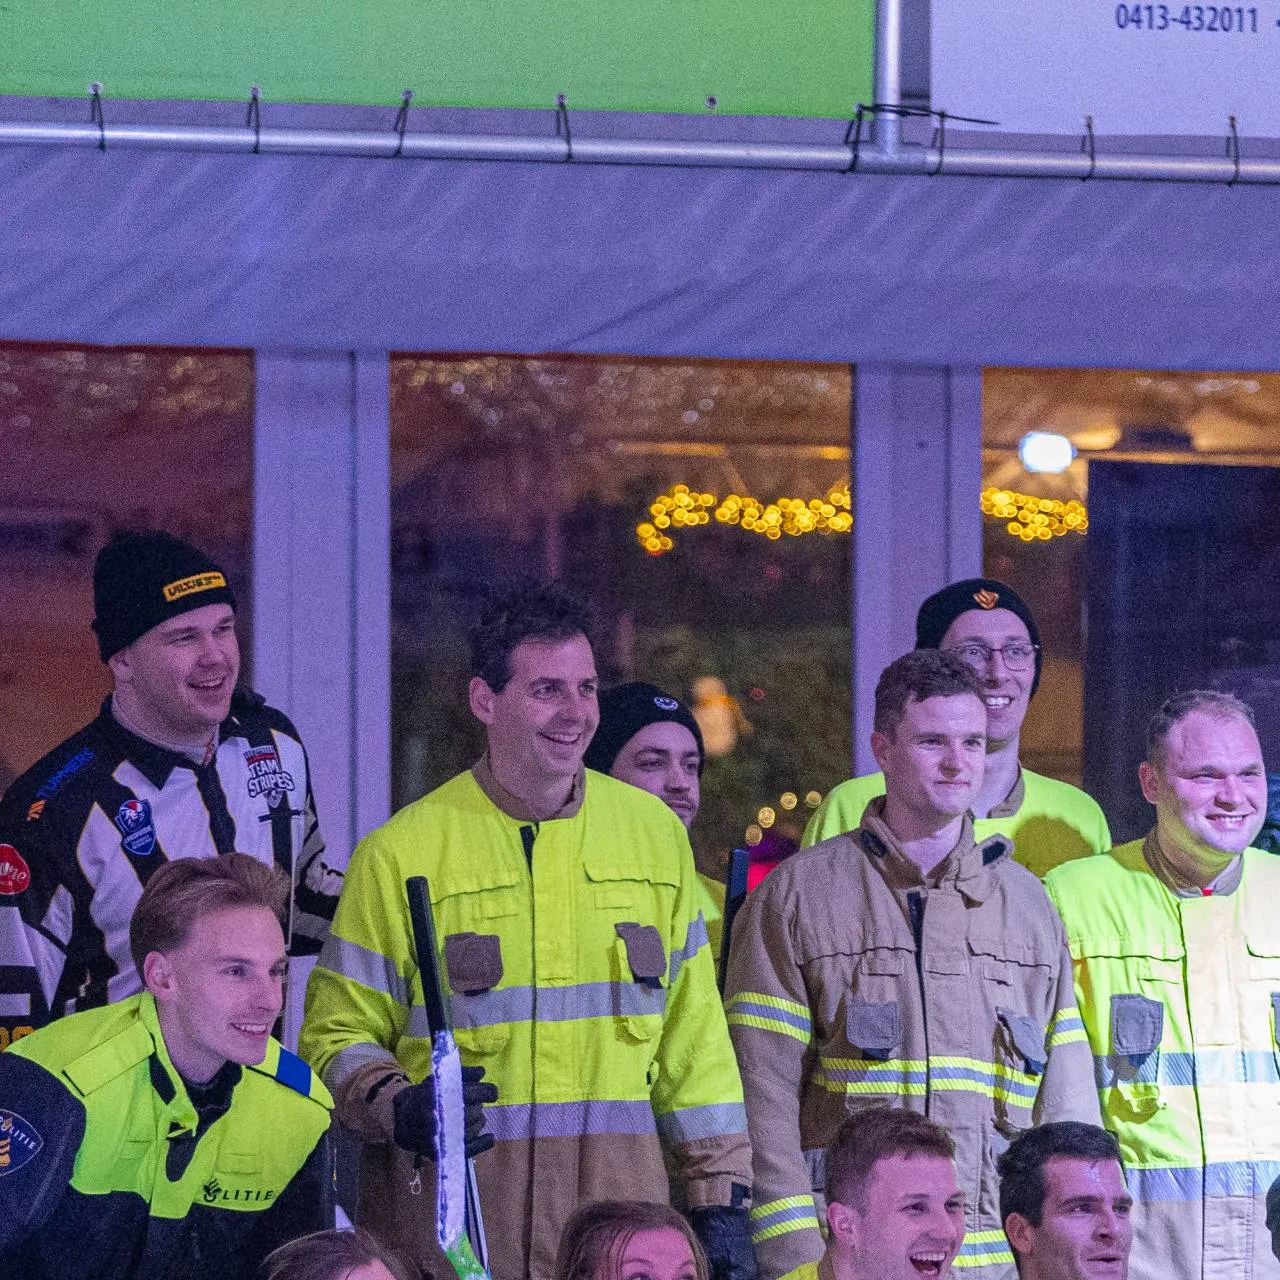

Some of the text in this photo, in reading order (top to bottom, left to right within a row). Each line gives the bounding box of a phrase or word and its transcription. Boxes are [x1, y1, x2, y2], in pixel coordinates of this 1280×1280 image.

[1116, 4, 1257, 33] 0413-432011
[248, 759, 279, 778] TEAM
[247, 772, 294, 797] STRIPES
[201, 1169, 273, 1204] OLITIE
